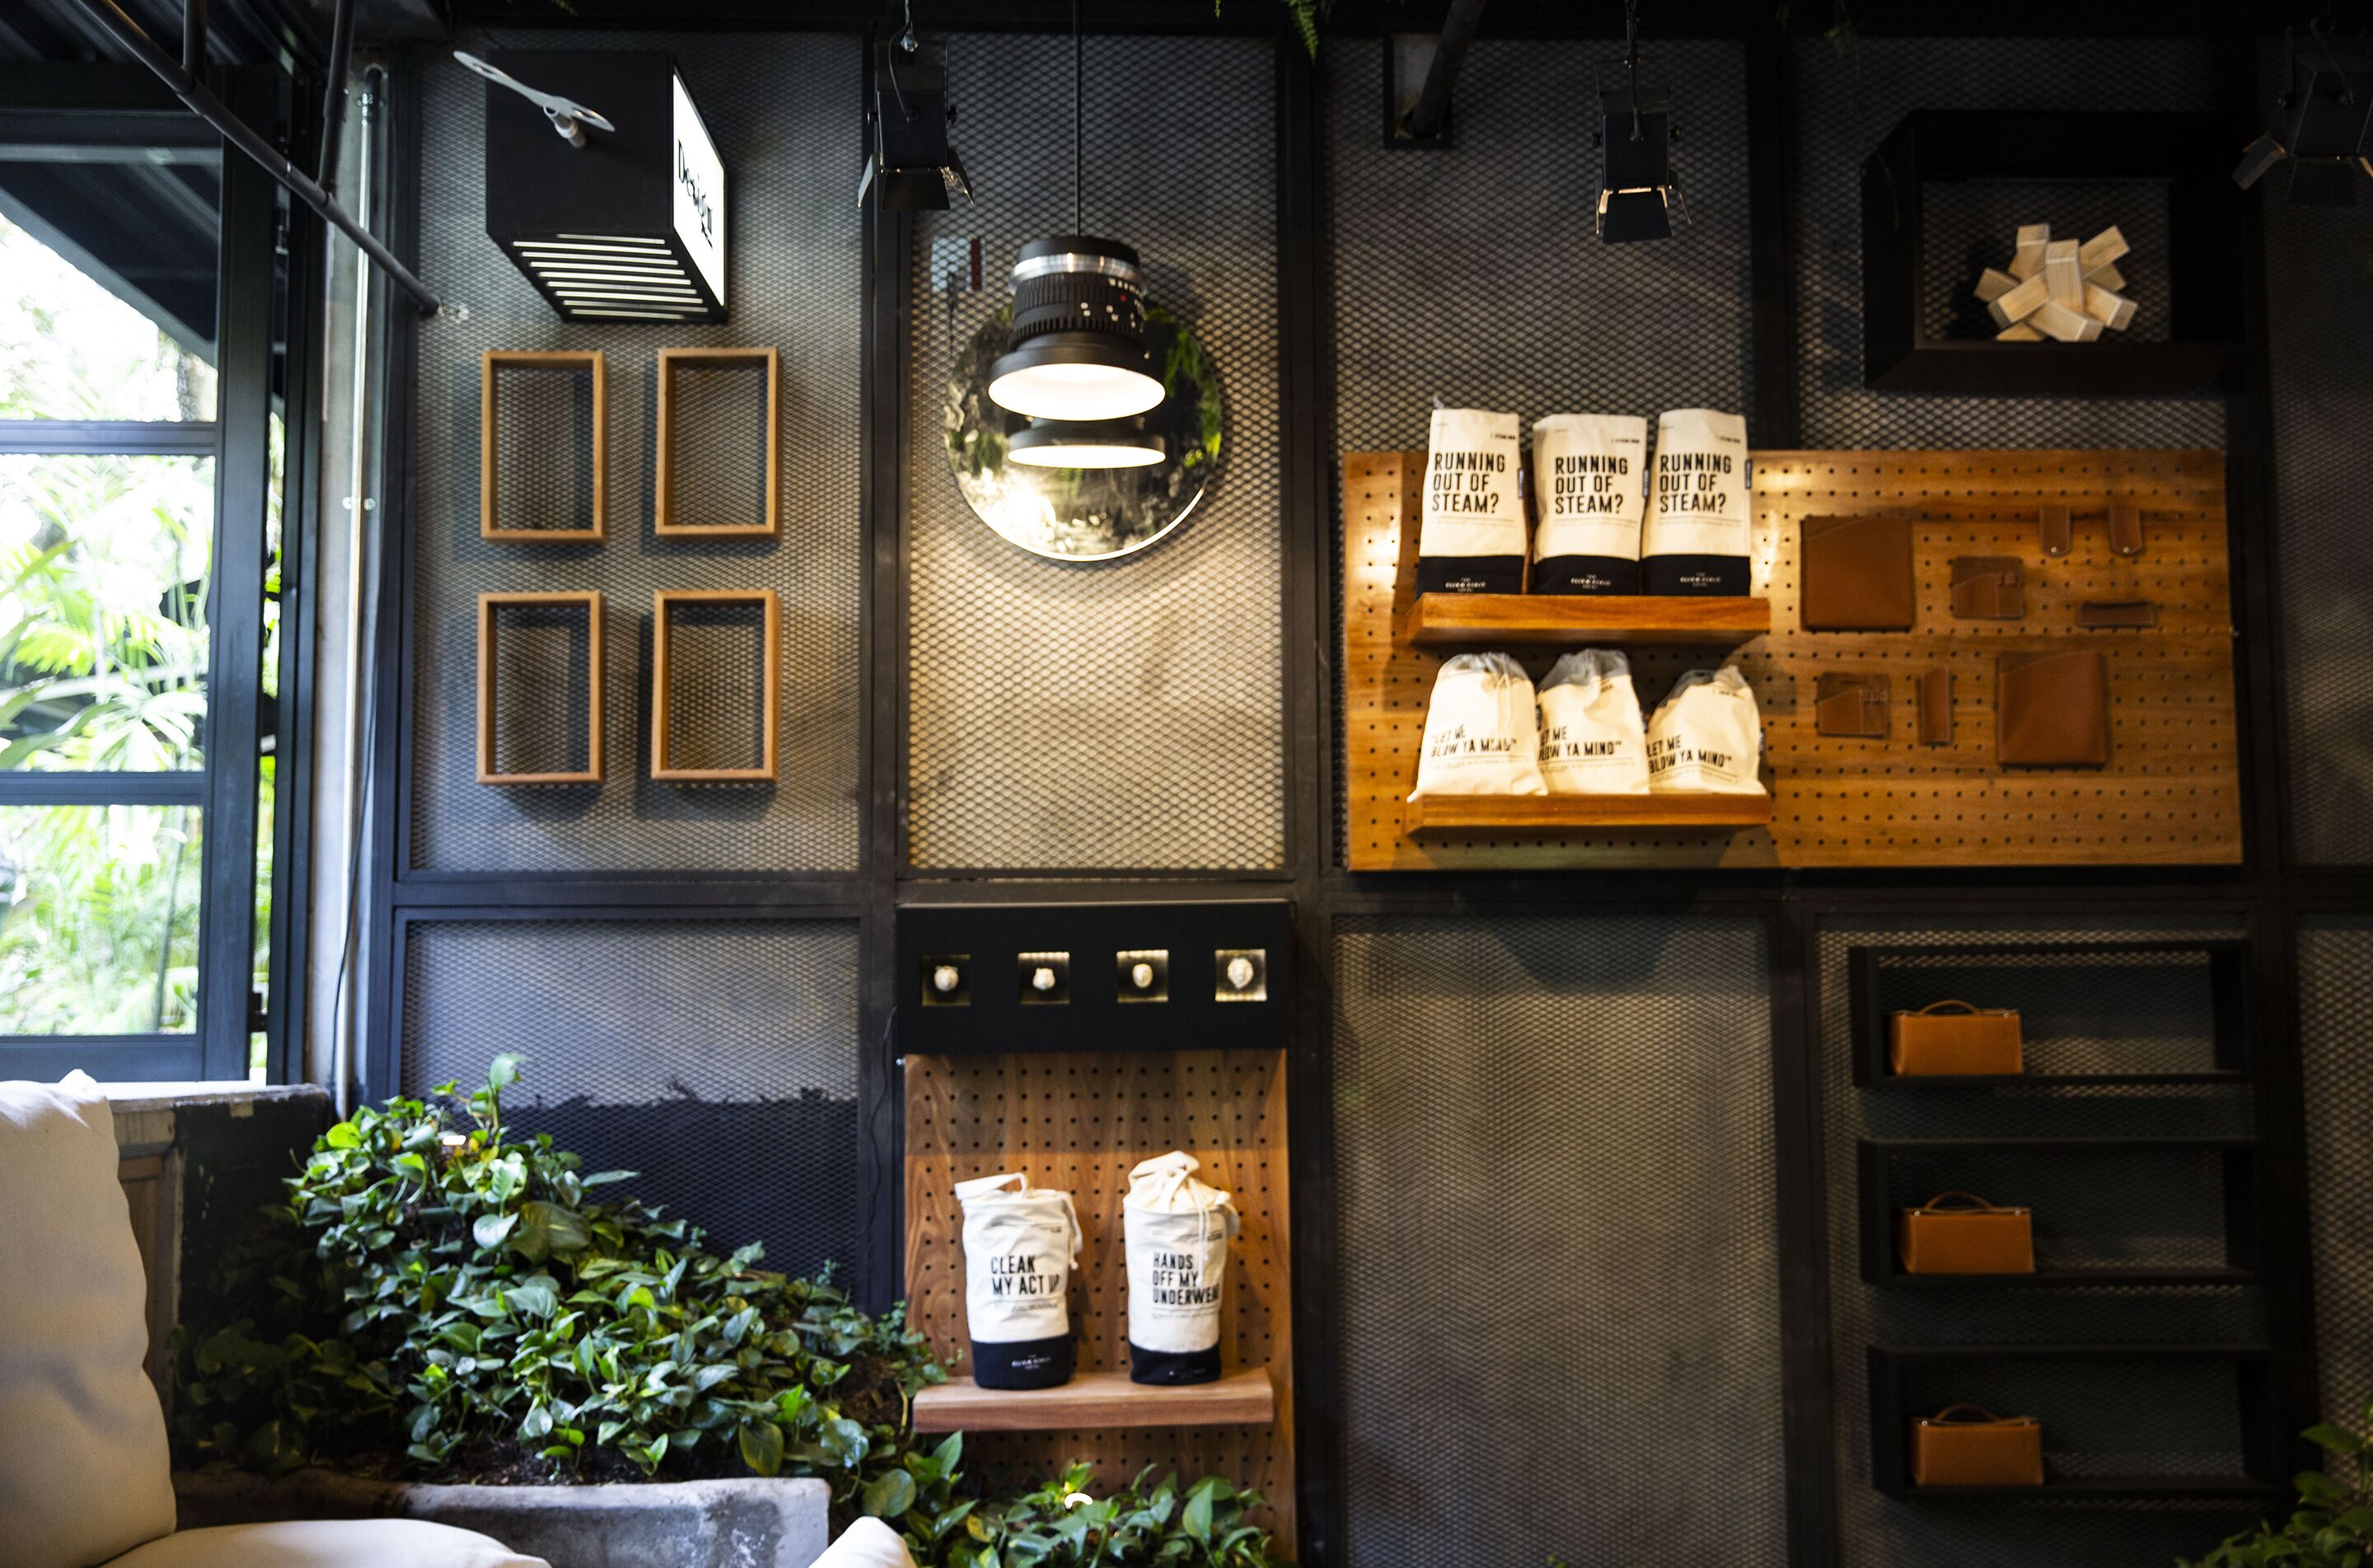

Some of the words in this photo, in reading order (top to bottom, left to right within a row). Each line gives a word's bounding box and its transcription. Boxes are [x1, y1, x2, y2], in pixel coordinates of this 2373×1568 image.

[1435, 452, 1505, 473] RUNNING
[1556, 456, 1627, 475] RUNNING
[1660, 453, 1731, 474] RUNNING
[1434, 472, 1463, 491] OUT
[1471, 473, 1490, 492] OF
[1556, 475, 1585, 494] OUT
[1594, 475, 1612, 493] OF
[1659, 474, 1690, 493] OUT
[1698, 474, 1716, 492] OF
[1432, 493, 1499, 514] STEAM?
[1556, 494, 1623, 514] STEAM?
[1659, 493, 1726, 513] STEAM?
[1553, 726, 1567, 741] ME
[1667, 734, 1682, 751] ME
[1566, 742, 1580, 756] YA
[1648, 753, 1676, 774] BLOW
[1681, 749, 1693, 763] YA
[991, 1255, 1036, 1275] CLEAN
[1154, 1253, 1194, 1271] HANDS
[992, 1275, 1013, 1295] MY
[1018, 1274, 1044, 1295] ACT
[1154, 1271, 1173, 1286] OFF
[1179, 1271, 1199, 1287] MY
